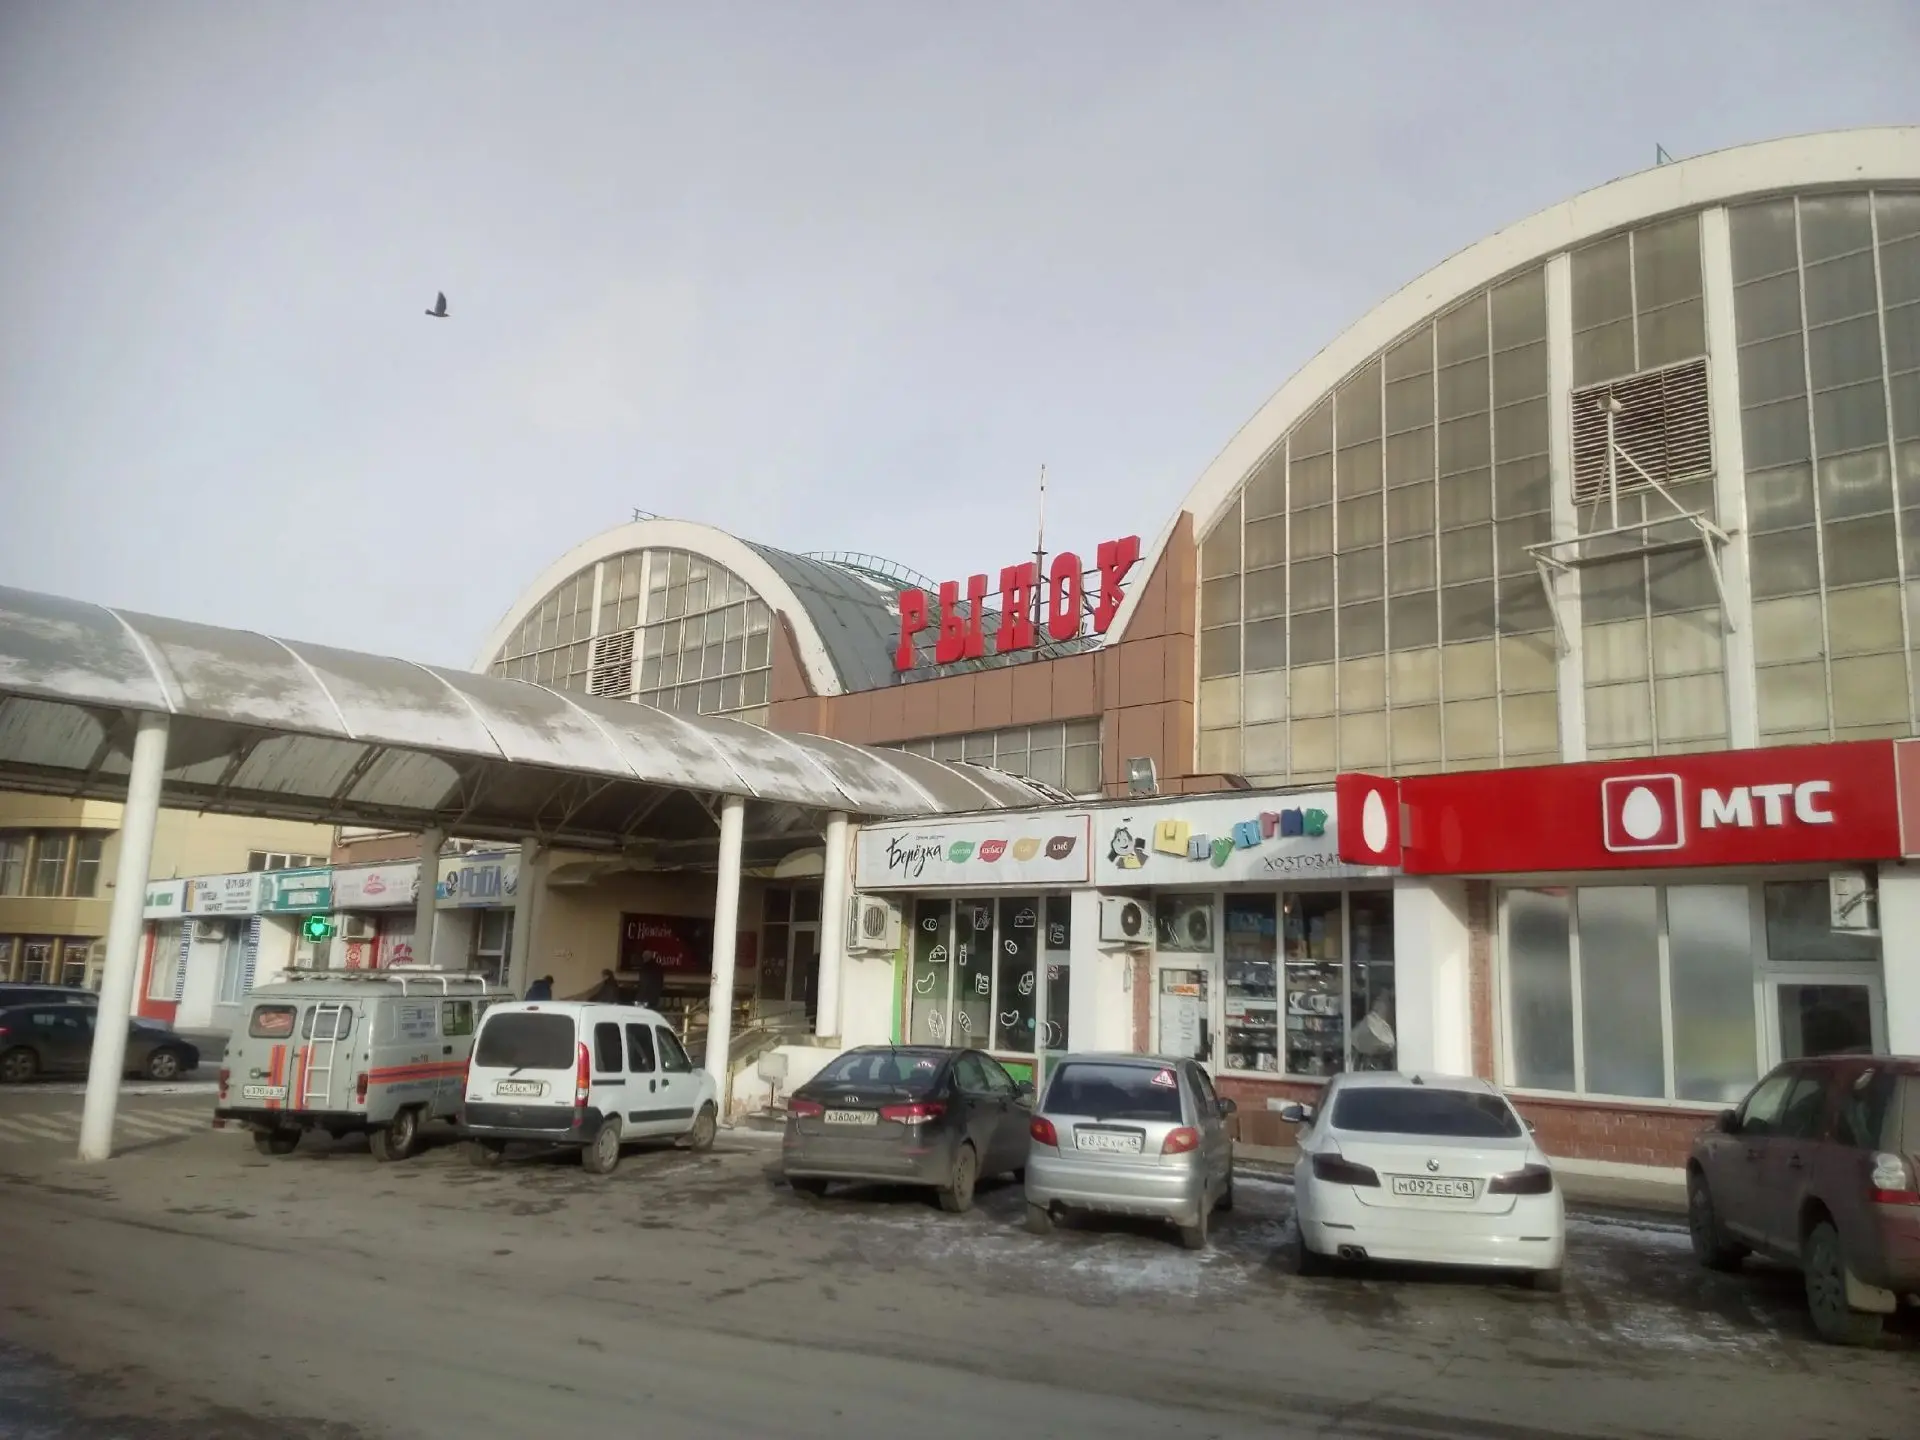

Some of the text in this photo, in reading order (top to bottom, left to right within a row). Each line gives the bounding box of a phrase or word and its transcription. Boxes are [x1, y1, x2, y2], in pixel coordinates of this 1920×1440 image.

[896, 535, 1140, 670] РЫНОК
[1700, 780, 1834, 828] МТС
[1398, 1180, 1468, 1194] М092ЕЕ 48
